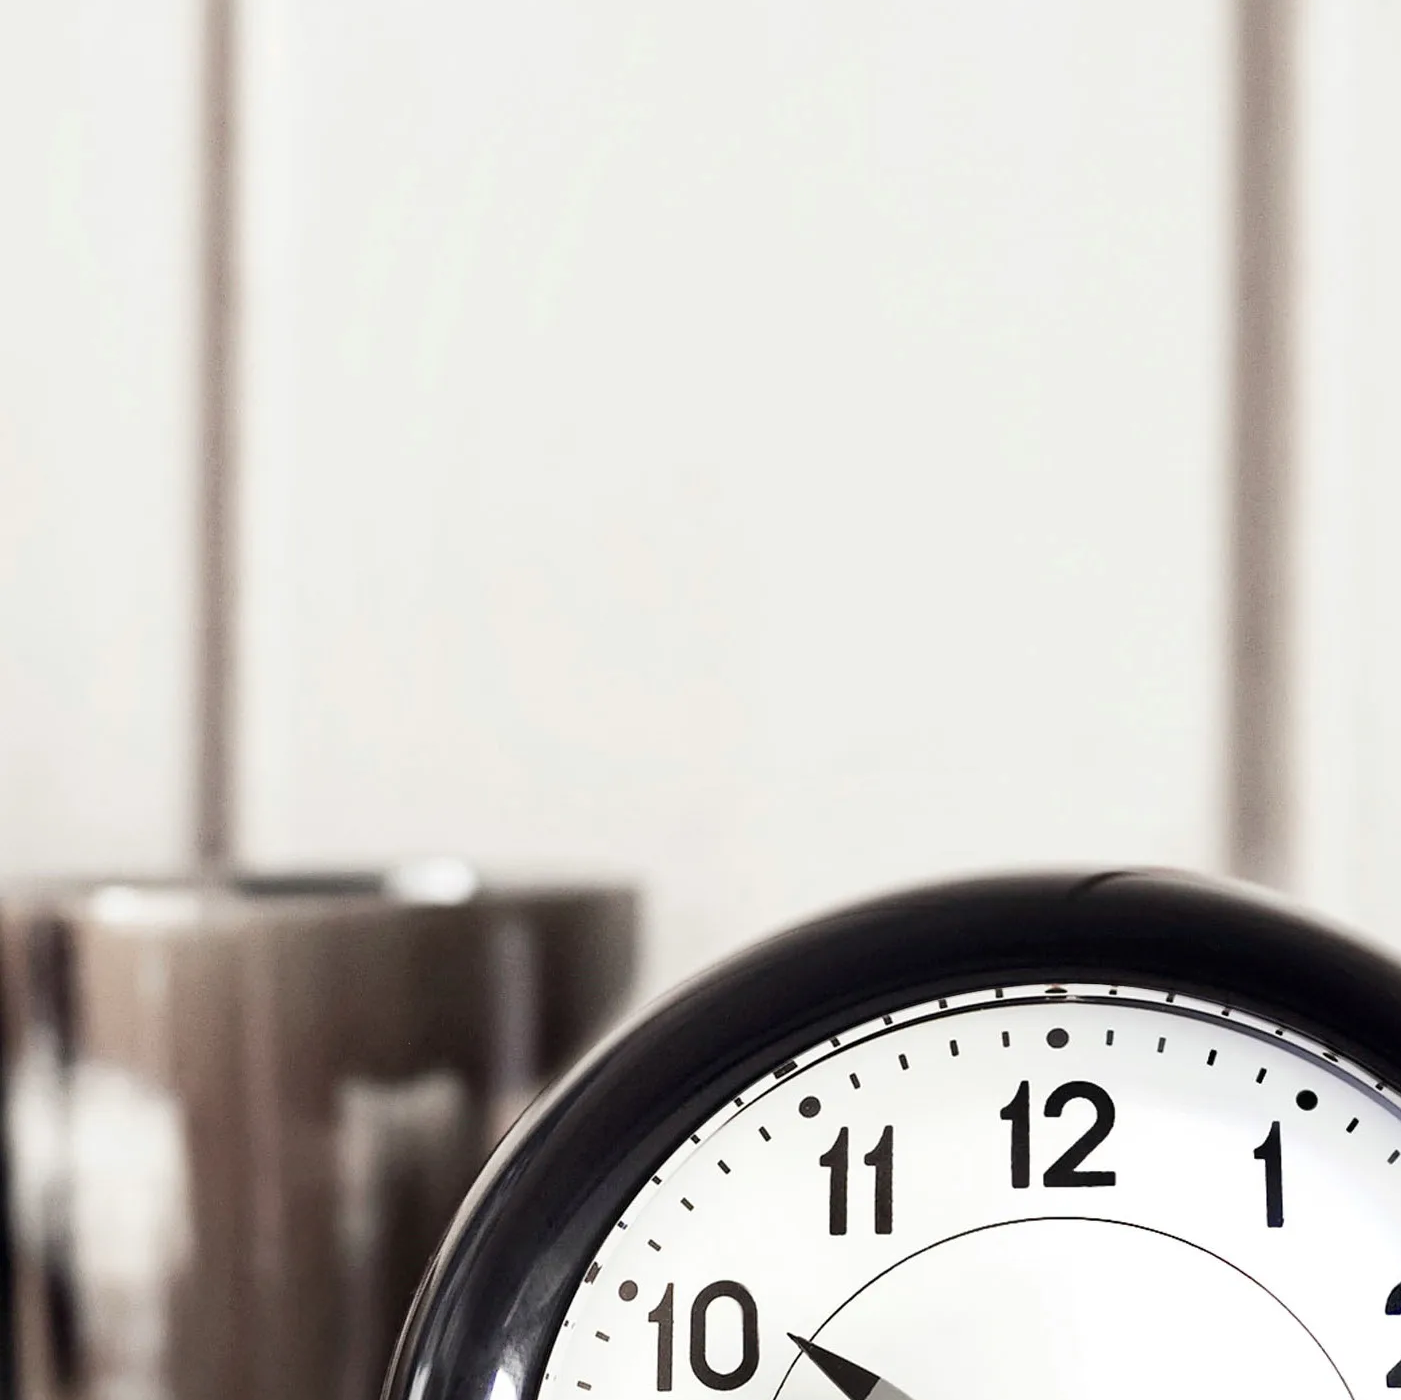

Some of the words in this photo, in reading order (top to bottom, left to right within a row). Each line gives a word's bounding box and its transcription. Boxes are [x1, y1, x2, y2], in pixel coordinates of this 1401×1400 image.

[819, 1125, 895, 1236] 11
[1000, 1080, 1117, 1190] 12
[1253, 1121, 1286, 1228] 1
[647, 1279, 759, 1392] 10
